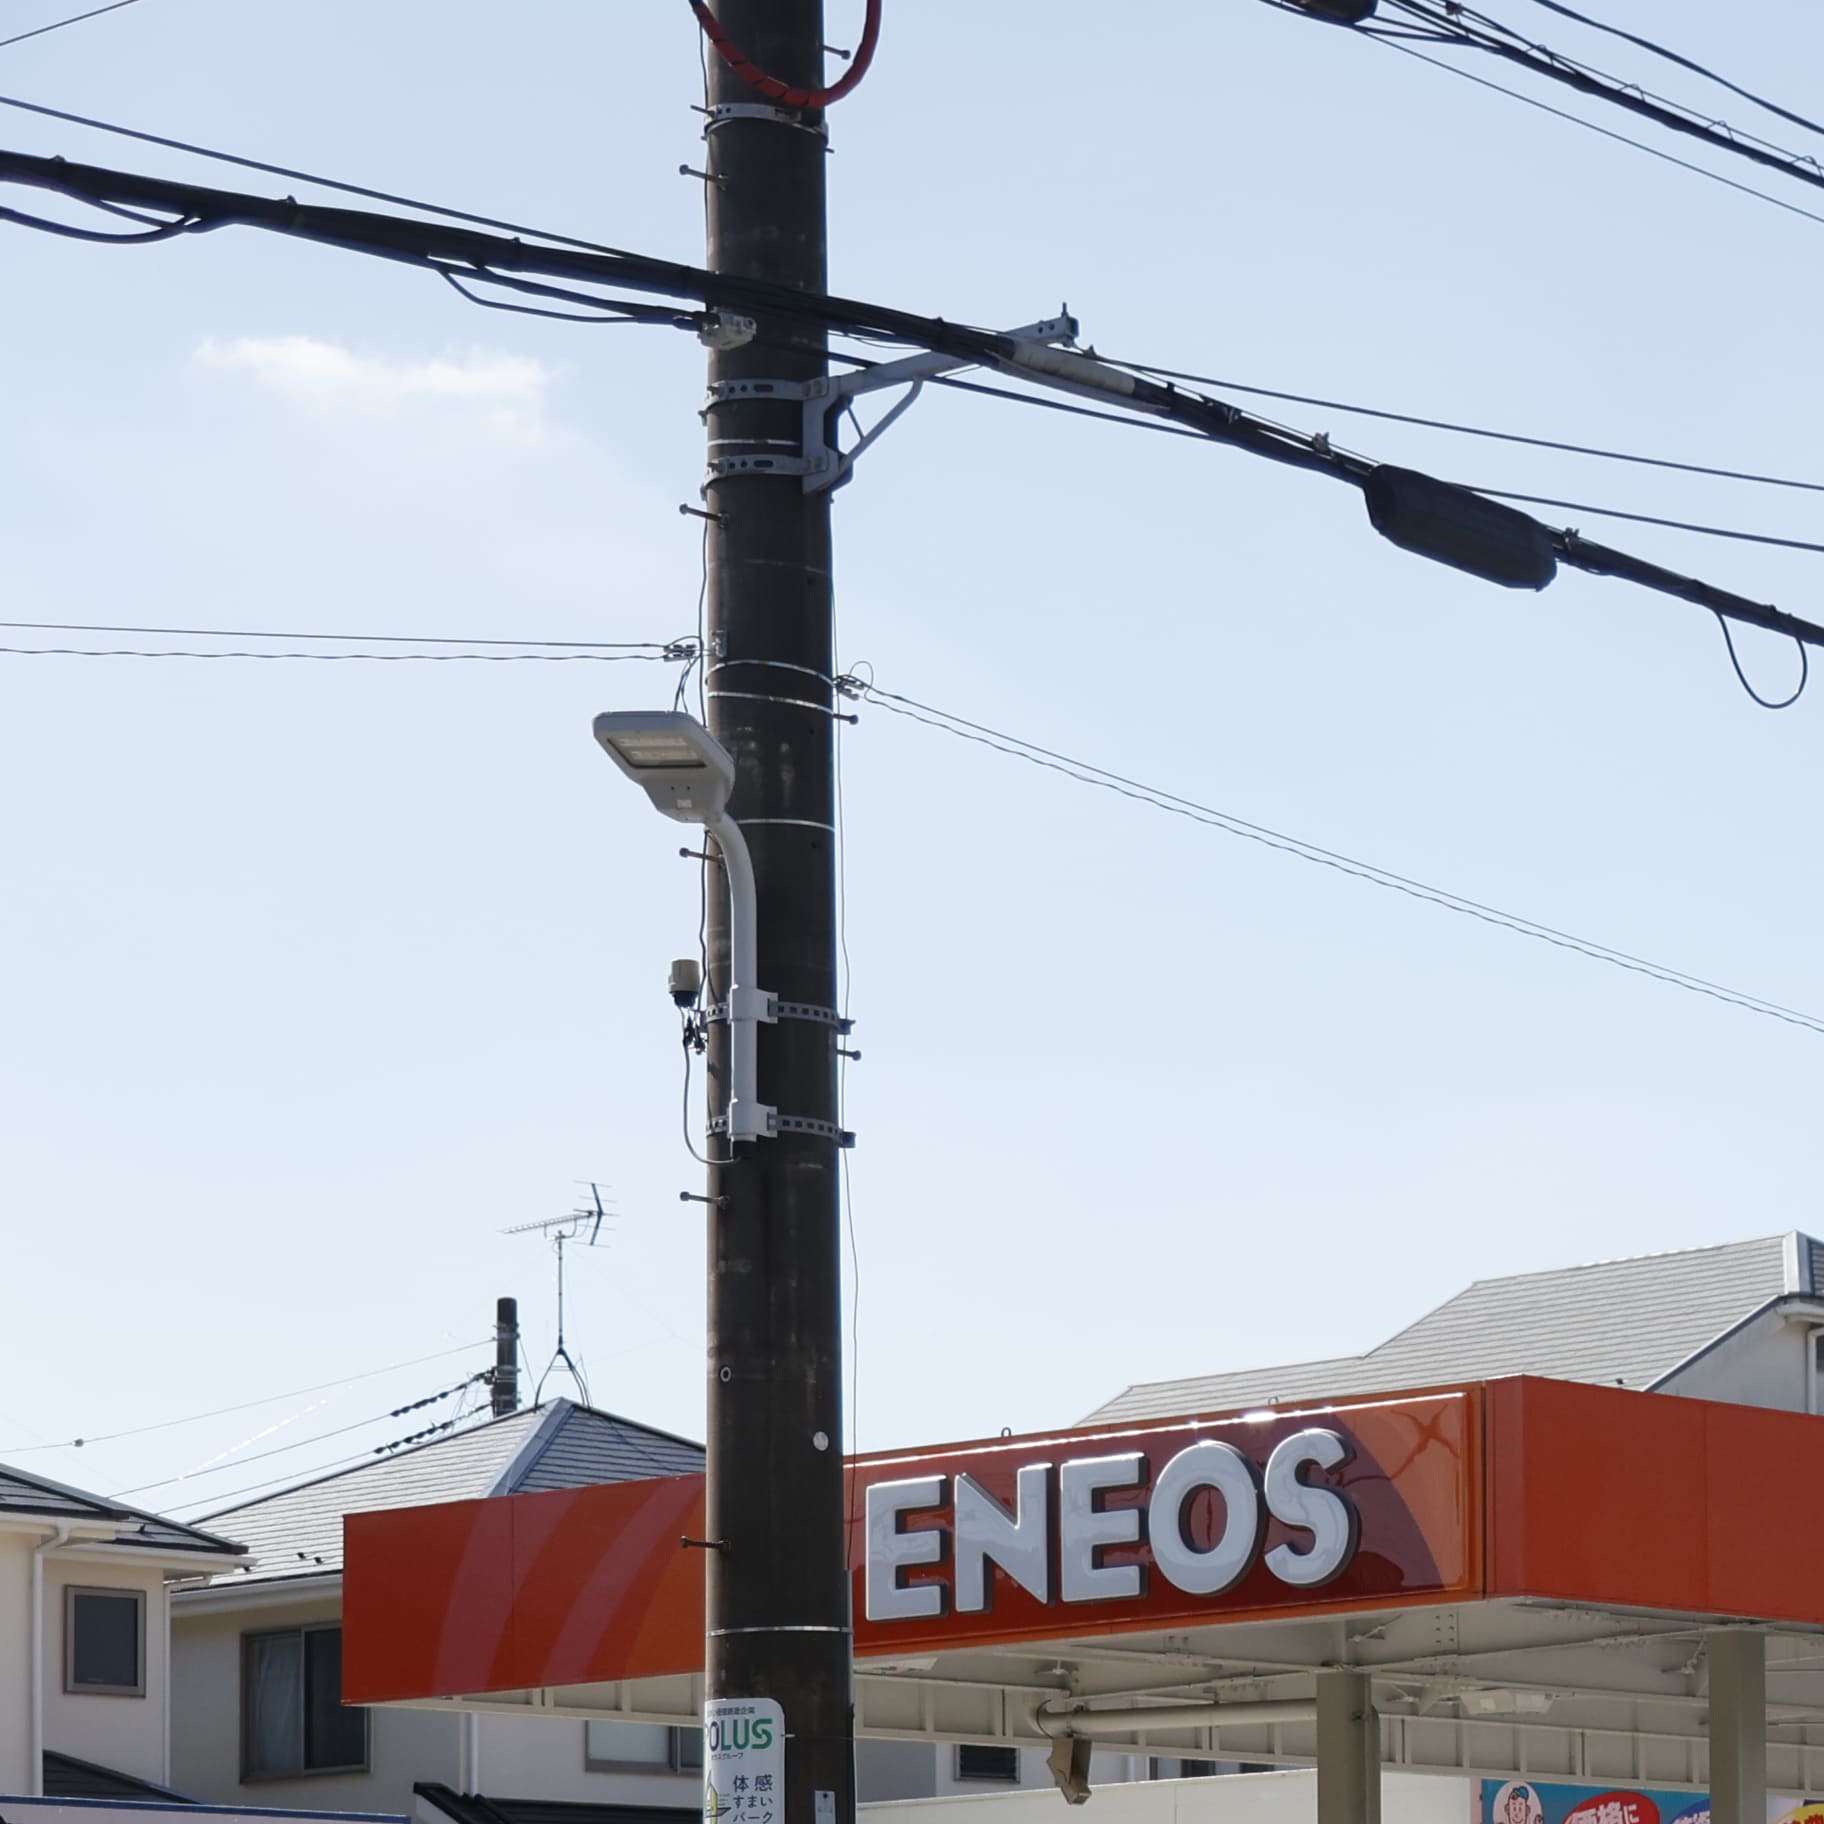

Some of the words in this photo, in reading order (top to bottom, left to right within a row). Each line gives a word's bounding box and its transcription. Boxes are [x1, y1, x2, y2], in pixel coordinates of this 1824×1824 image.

[865, 1427, 1360, 1622] ENEOS
[704, 1718, 774, 1752] OLUS
[732, 1774, 774, 1793] 体感
[733, 1795, 774, 1809] すまい
[732, 1811, 774, 1824] パーク
